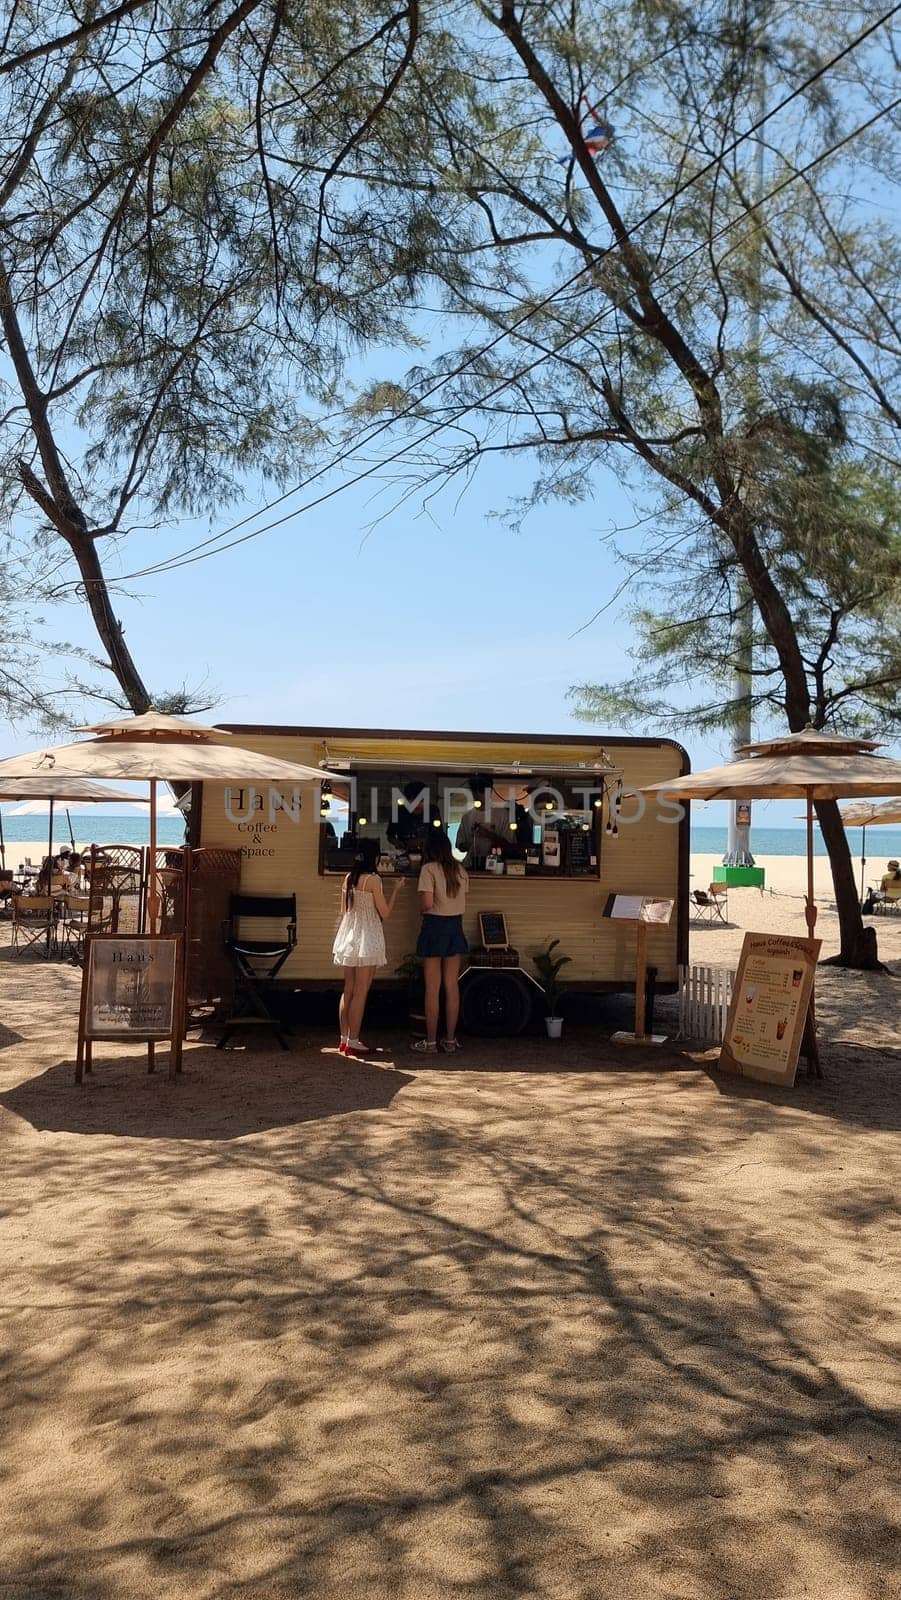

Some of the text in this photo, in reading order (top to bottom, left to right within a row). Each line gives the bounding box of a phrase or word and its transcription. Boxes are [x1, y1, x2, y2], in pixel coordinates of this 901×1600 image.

[224, 787, 302, 811] Haus
[238, 822, 278, 832] Coffee
[252, 833, 262, 844] &
[240, 845, 275, 858] Space
[113, 952, 155, 962] Haus
